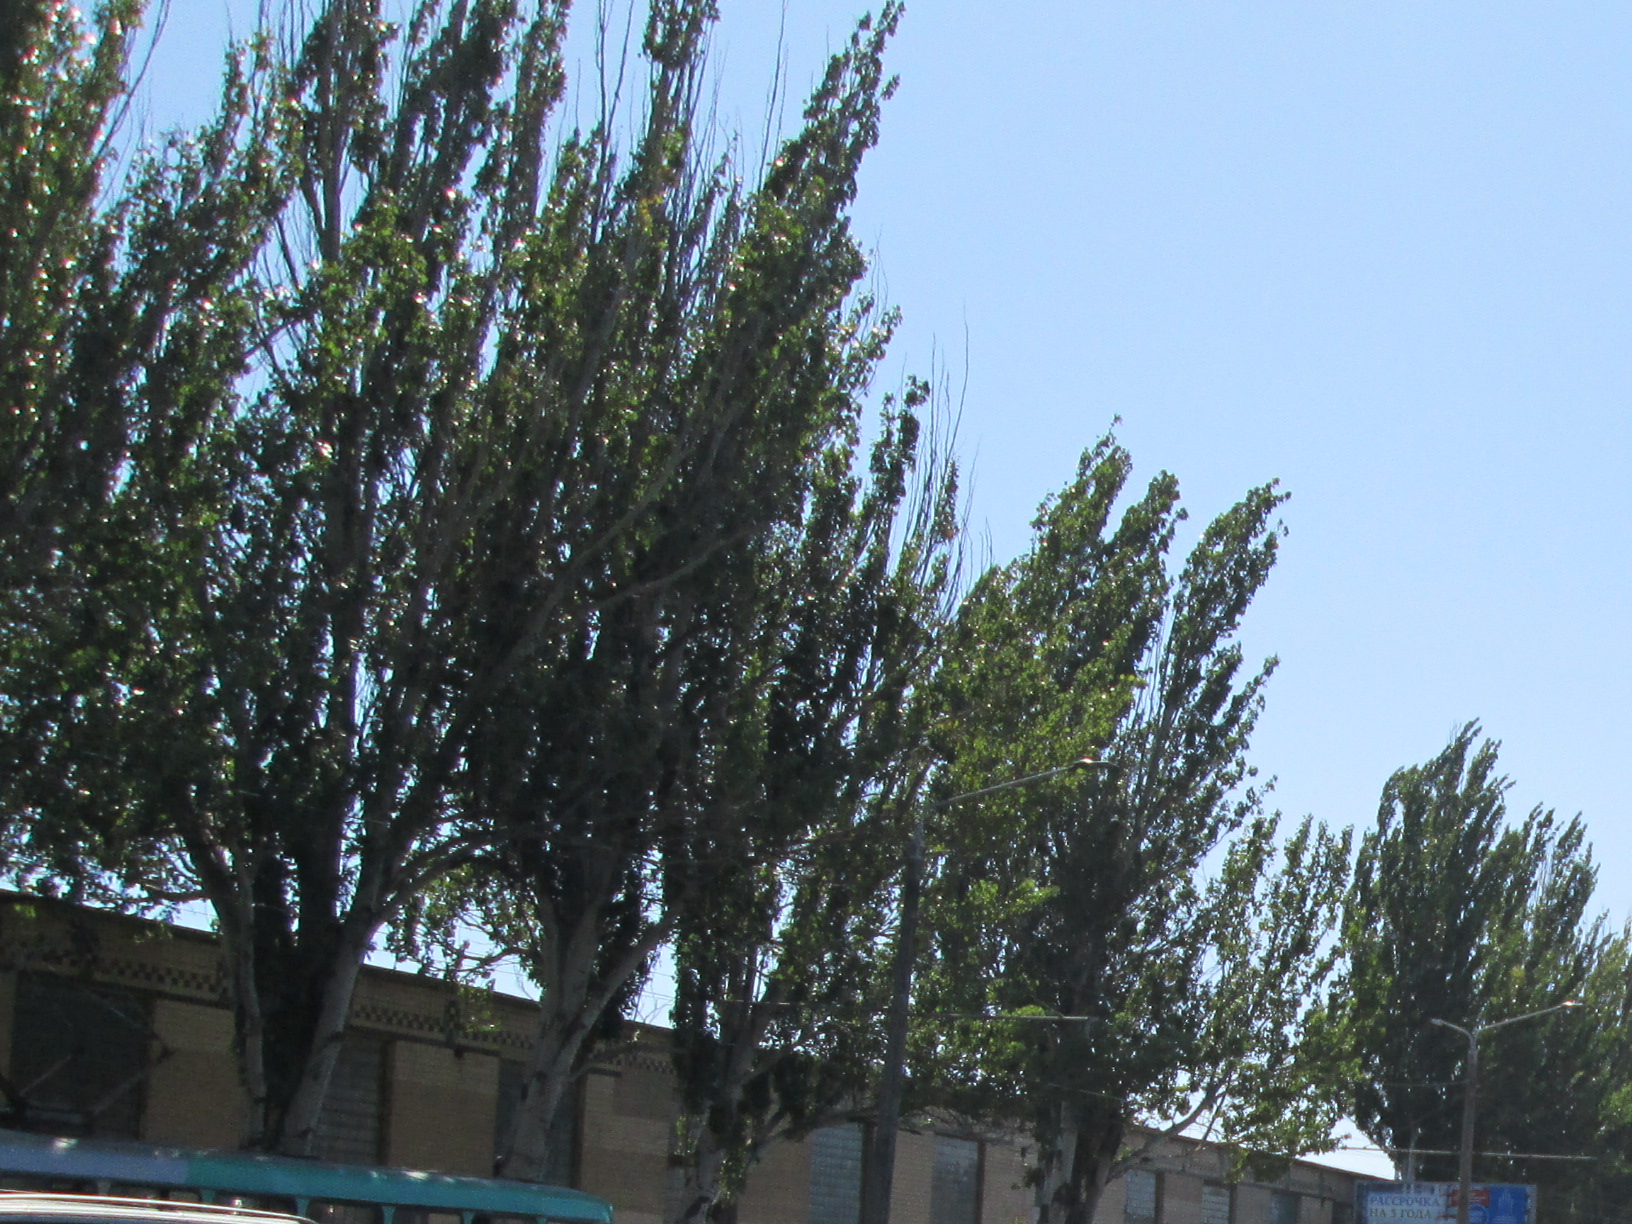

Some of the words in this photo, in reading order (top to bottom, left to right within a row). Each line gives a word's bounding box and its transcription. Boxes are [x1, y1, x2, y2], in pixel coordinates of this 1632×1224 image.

[1370, 1196, 1440, 1207] РАССРОЧКА
[1370, 1208, 1386, 1218] НА
[1400, 1208, 1432, 1219] ГОДА
